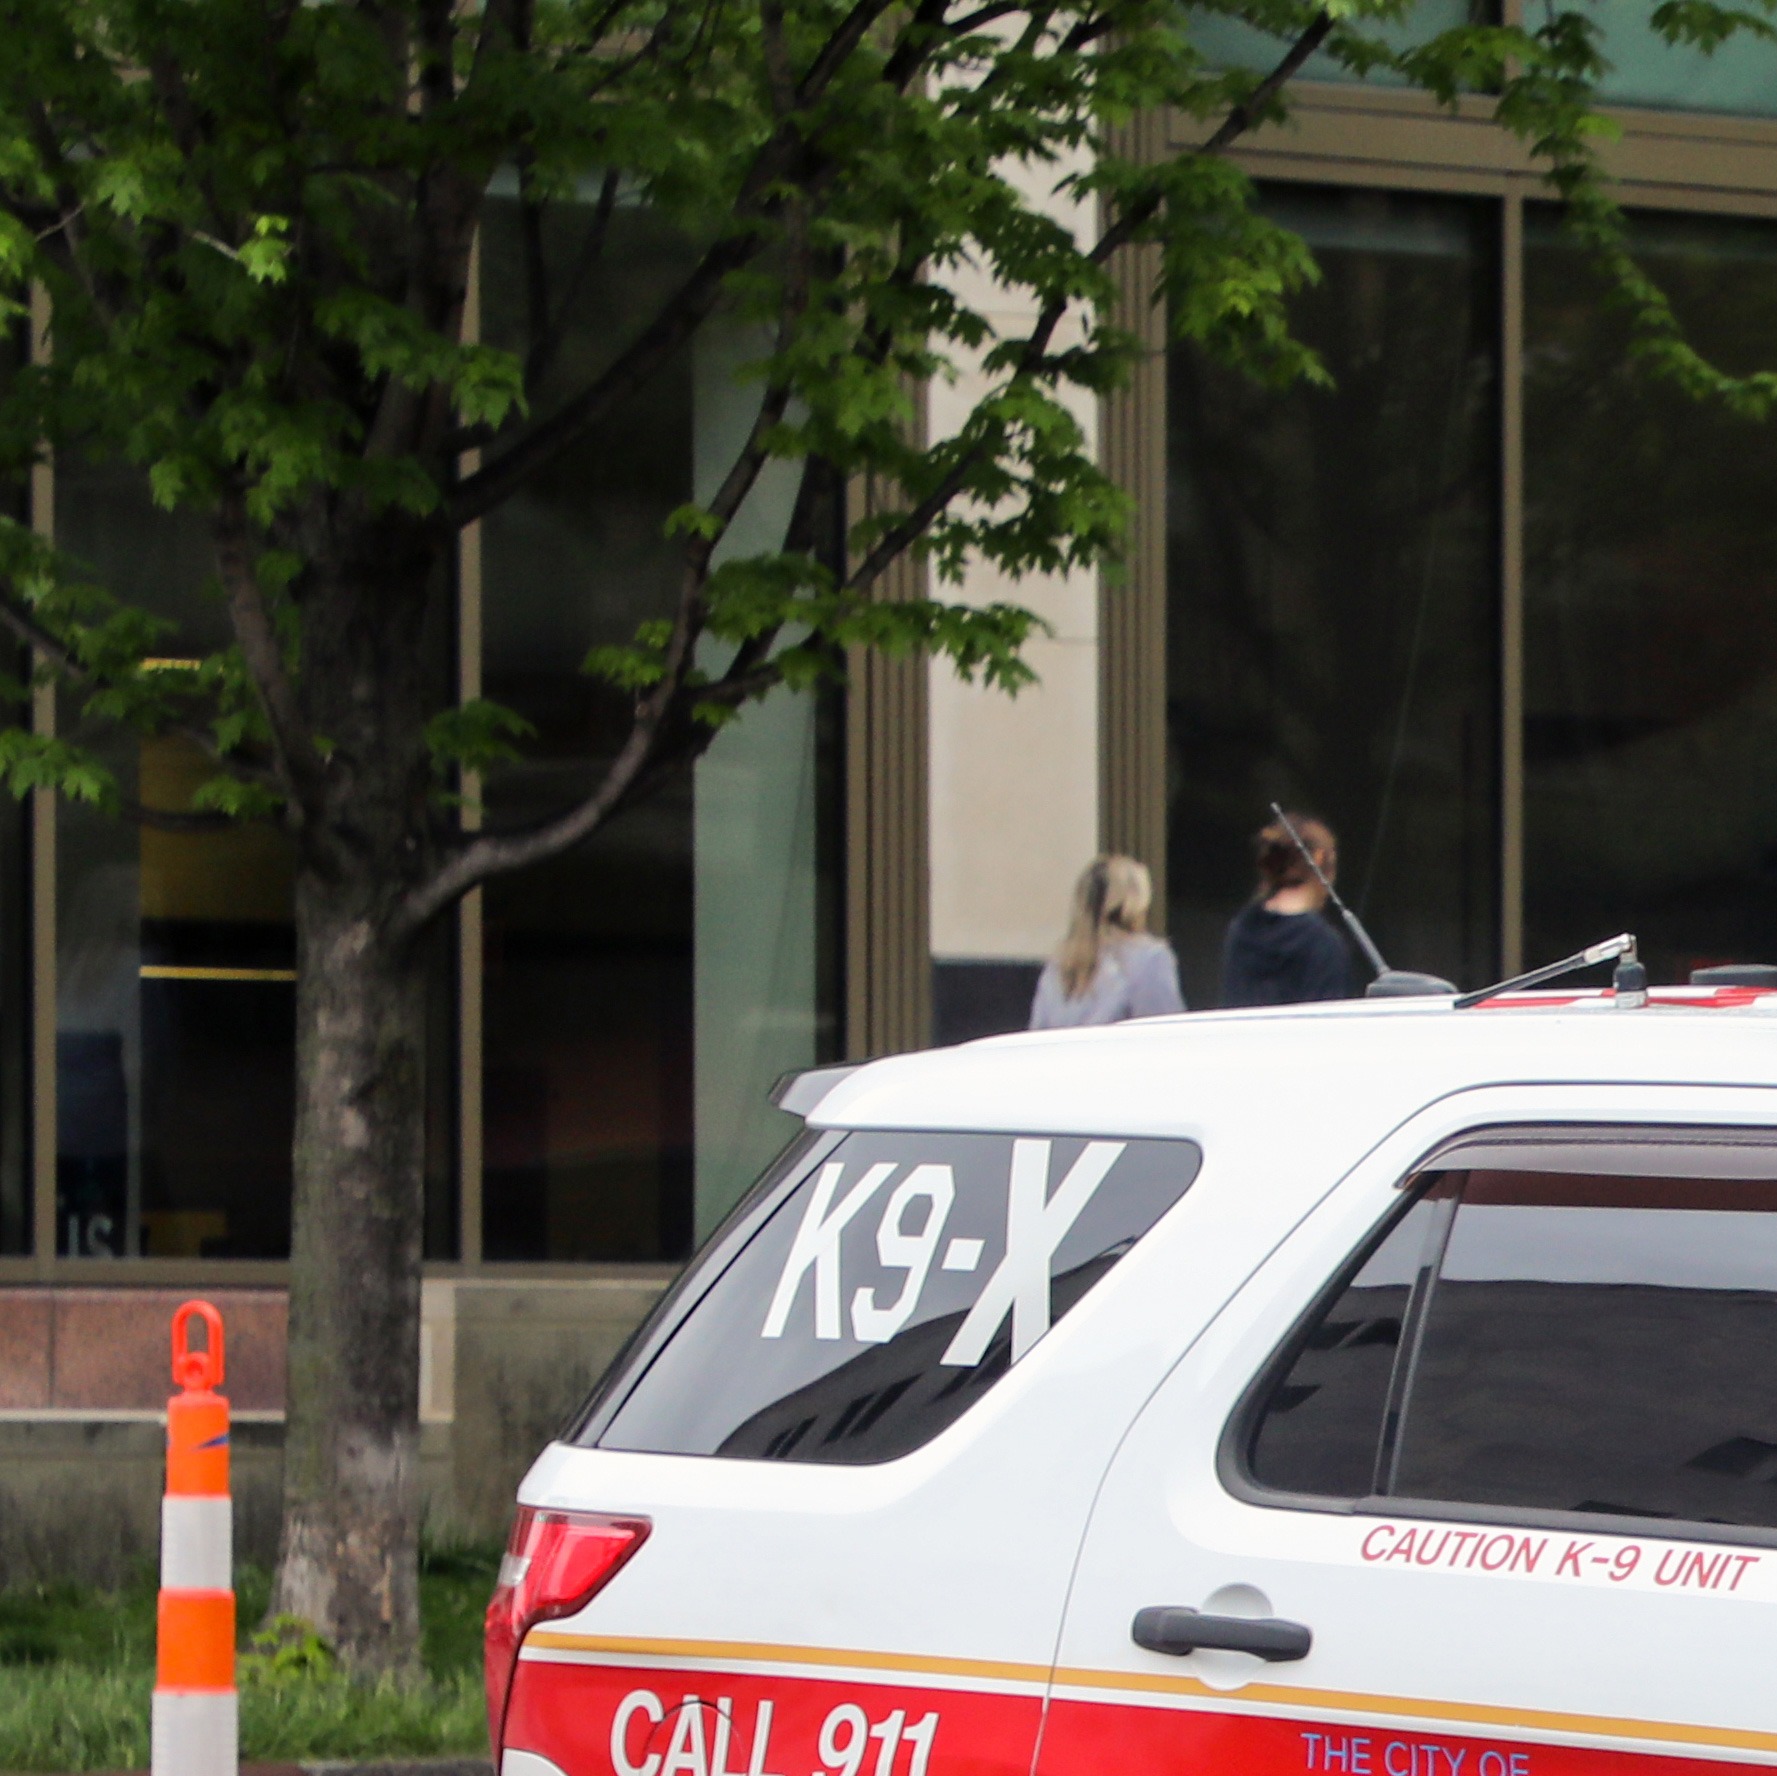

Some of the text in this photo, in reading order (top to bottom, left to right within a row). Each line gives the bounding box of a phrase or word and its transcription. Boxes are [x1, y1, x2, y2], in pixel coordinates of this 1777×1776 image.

[762, 1139, 1125, 1367] K9-X
[1360, 1525, 1759, 1592] CAUTION K-9 UNIT
[1301, 1732, 1371, 1774] THE
